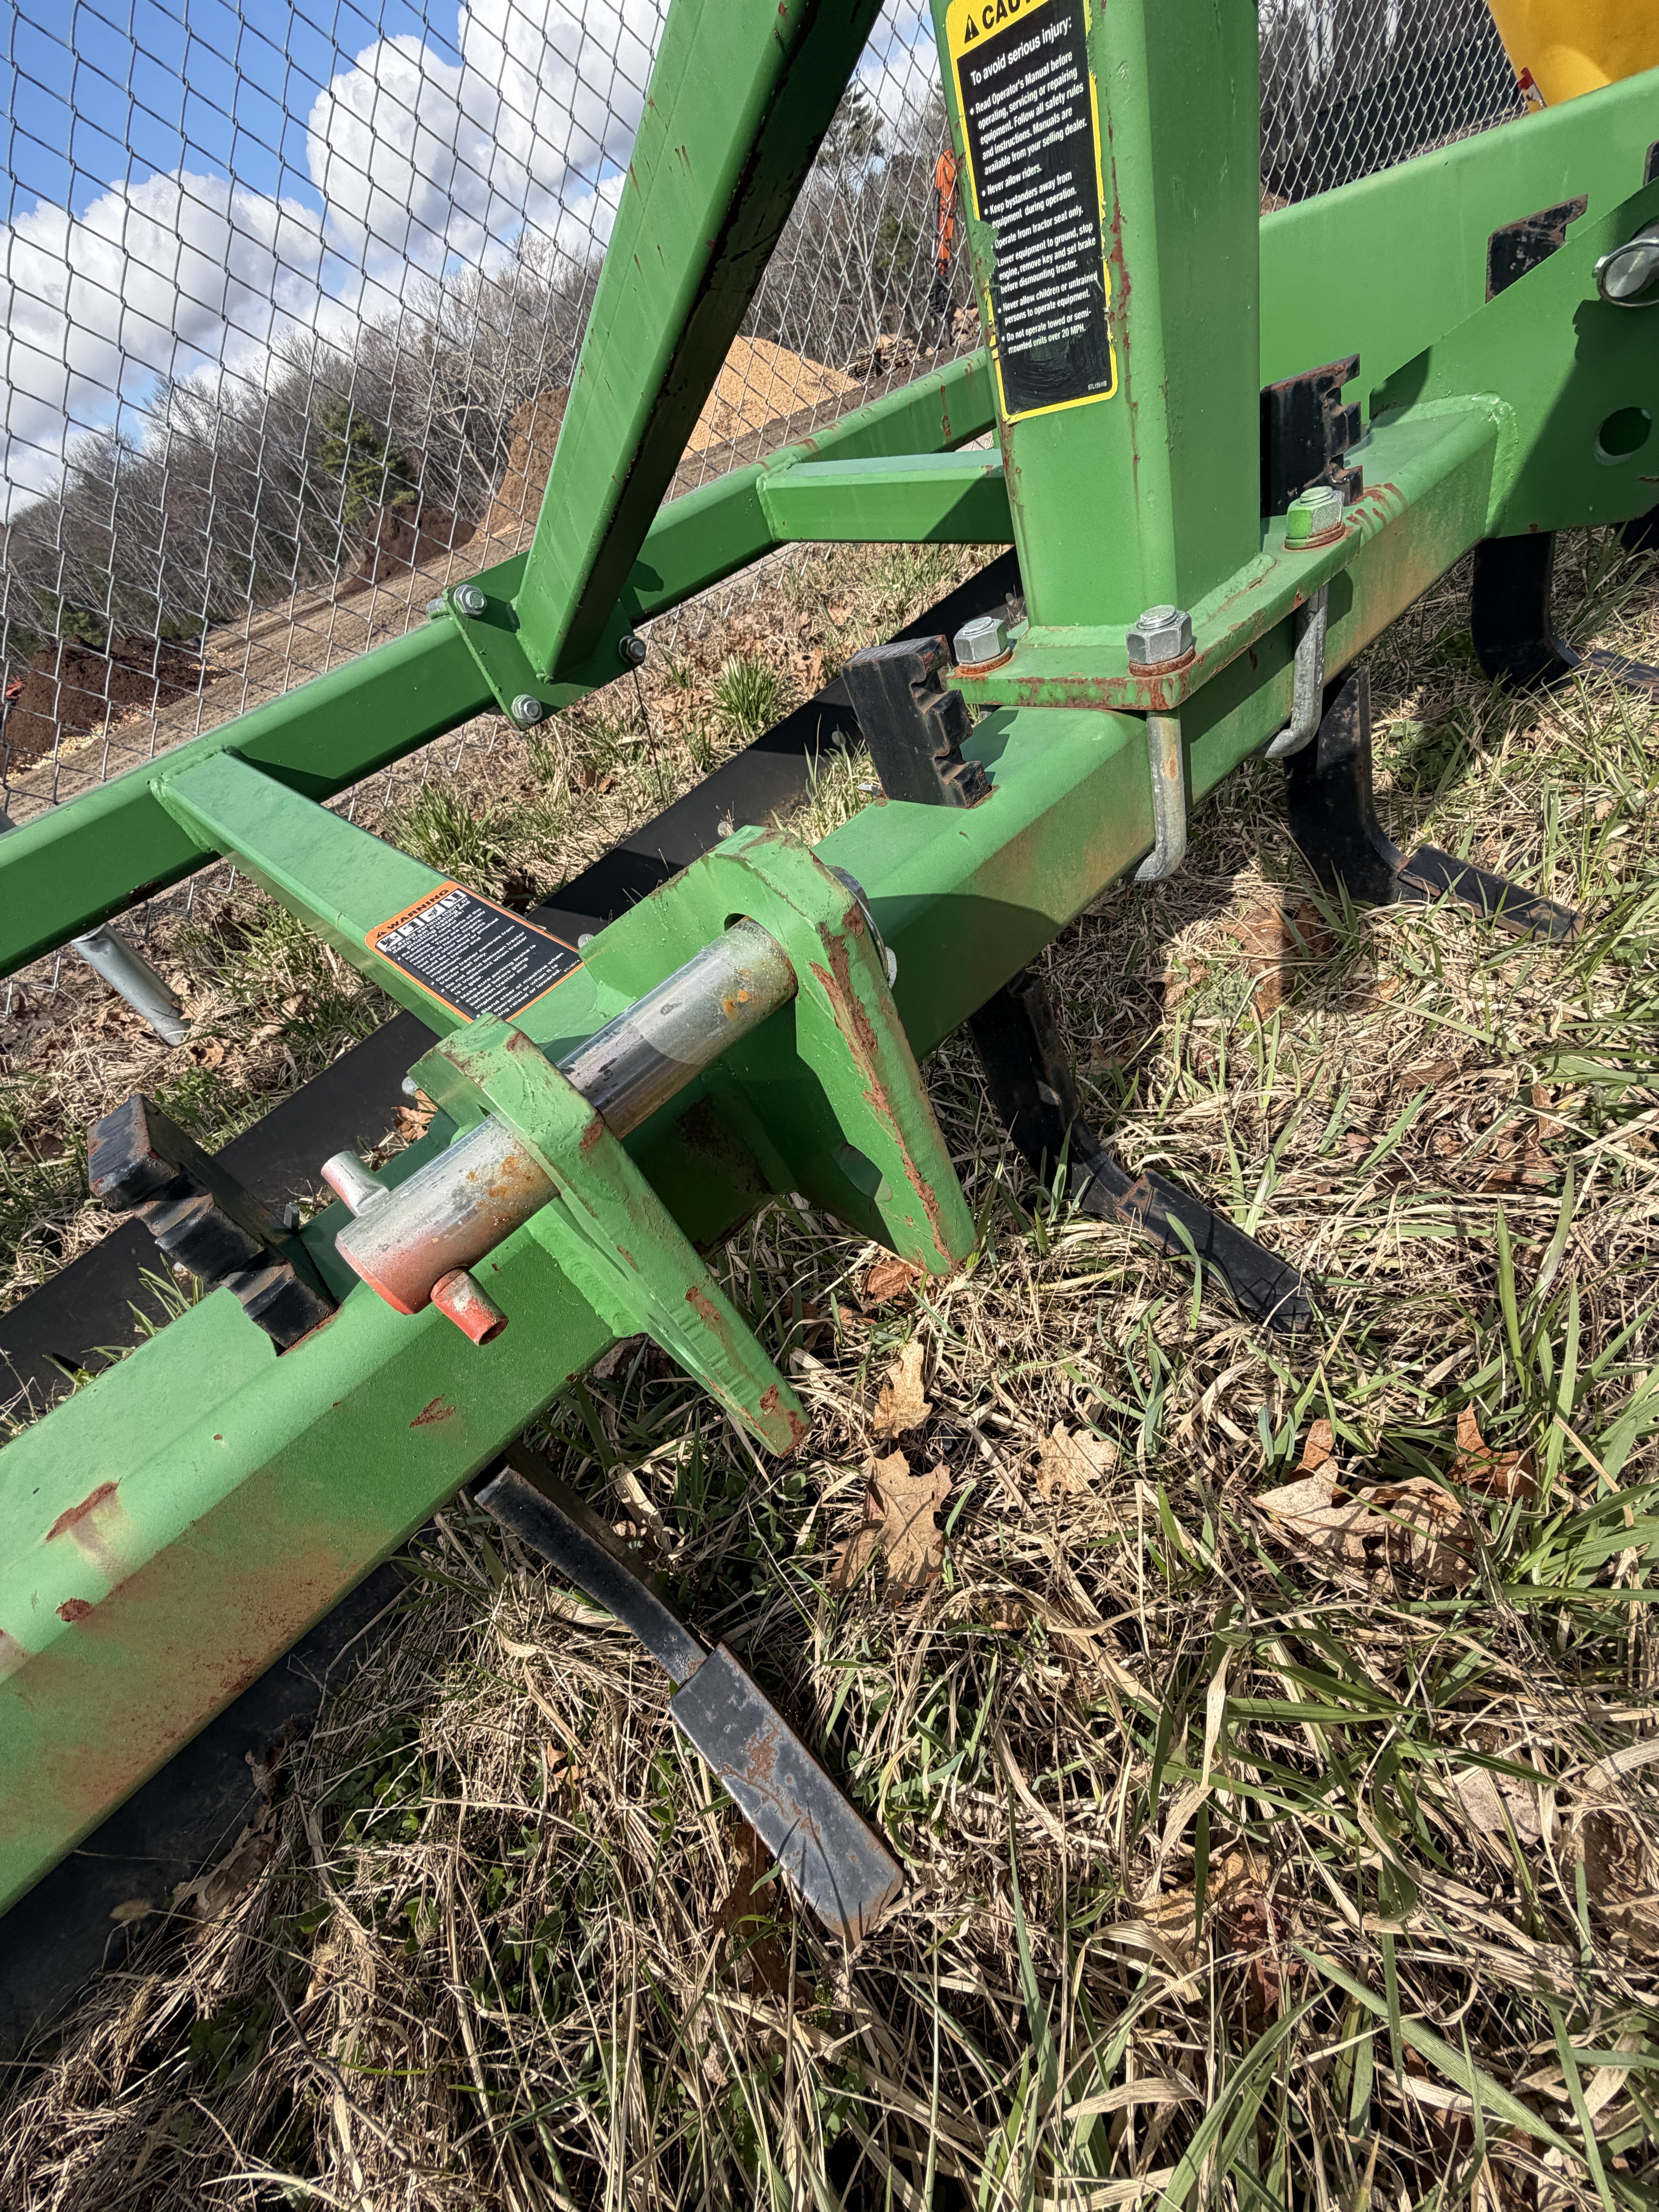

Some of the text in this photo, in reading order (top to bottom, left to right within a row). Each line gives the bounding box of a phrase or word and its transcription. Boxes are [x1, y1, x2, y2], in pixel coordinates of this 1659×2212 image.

[982, 0, 1030, 29] CAU
[970, 16, 1072, 86] To avoid serious injury:
[975, 51, 1072, 114] Read Operator's Manual before
[978, 67, 1078, 130] operating, servicing or repairing
[980, 83, 1084, 145] equipment. Follow all safety rules
[982, 107, 1072, 160] and instructions. Manuals are
[984, 118, 1087, 175] available from your selling dealer.
[987, 164, 1042, 195] Never allow riders.
[989, 171, 1072, 215] Keep bystanders away from
[991, 186, 1077, 230] equipment during operation.
[994, 205, 1084, 249] Operate from tractor seat only.
[996, 222, 1093, 267] Lower equipment to ground, stop
[999, 237, 1096, 281] engine, remove key and set brake
[1000, 259, 1078, 294] before dismounting tractor.
[1003, 270, 1097, 312] Never allow children or untrained
[1005, 288, 1091, 326] persons to operate equipment.
[1006, 307, 1091, 342] Do not operate towed or semi-
[1008, 323, 1086, 354] mounted units over 20 MPH.
[386, 889, 449, 929] WARNING
[392, 900, 471, 953] death from crushing and
[398, 933, 416, 946] avoid
[417, 916, 441, 933] serious
[441, 903, 460, 917] injury
[405, 943, 431, 960] handling
[430, 929, 452, 943] various
[452, 919, 466, 930] parts
[406, 929, 436, 950] pinching
[409, 946, 435, 963] machine.
[435, 936, 450, 945] They
[460, 910, 485, 929] extremely
[410, 933, 437, 951] extremely
[438, 919, 457, 933] careful
[417, 922, 486, 969] feet and other body parts
[422, 960, 438, 972] could
[447, 938, 470, 955] crushed
[477, 917, 499, 934] pinched
[425, 936, 481, 975] between tractor and
[435, 926, 515, 982] Operate tractor controls from
[466, 962, 483, 975] stand
[482, 945, 507, 963] between
[506, 931, 524, 946] tractor
[429, 957, 462, 978] implement.
[450, 936, 527, 992] and implement when tractor
[460, 987, 477, 999] Make
[477, 977, 491, 988] sure
[491, 962, 514, 978] parking
[513, 949, 530, 962] brake
[465, 957, 529, 1003] engaged before going
[469, 964, 528, 1006] between tractor and
[481, 1000, 500, 1014] Stand
[500, 989, 515, 1000] clear
[522, 965, 548, 984] machine
[547, 952, 564, 965] when
[474, 986, 509, 1010] implement.
[493, 991, 523, 1012] operation
[530, 973, 547, 985] when
